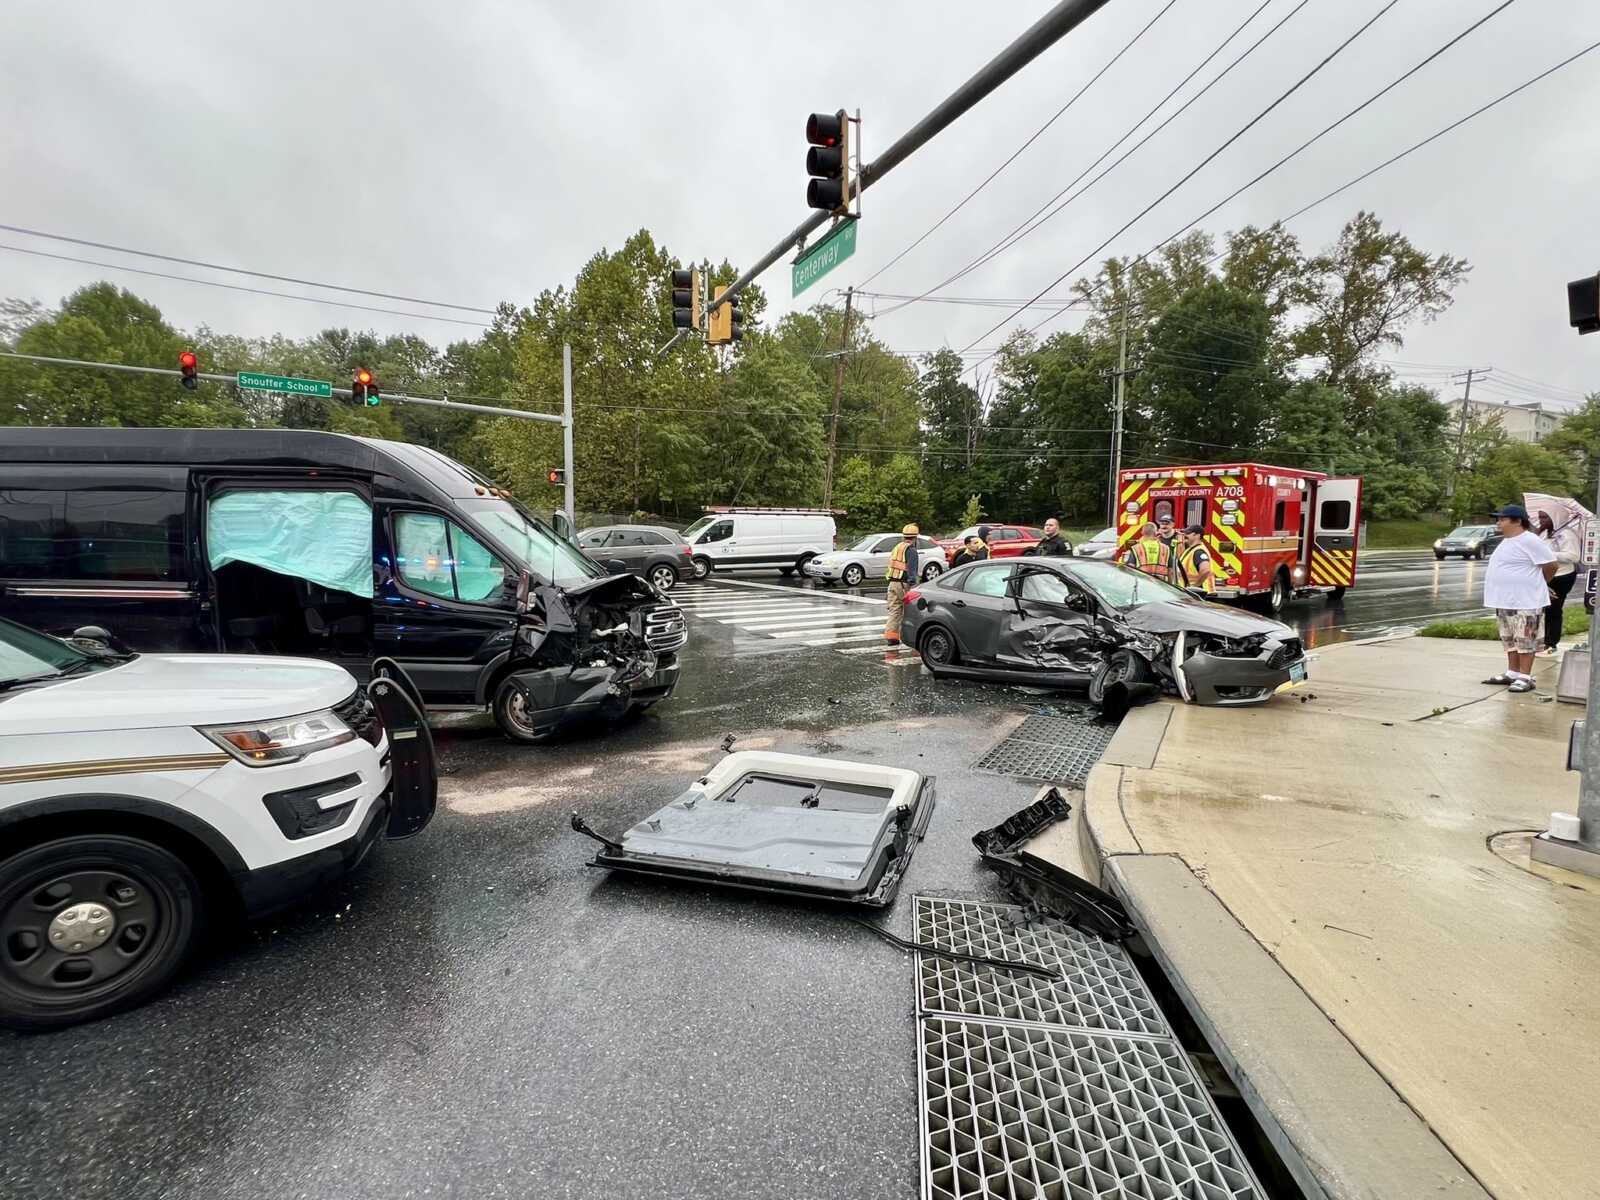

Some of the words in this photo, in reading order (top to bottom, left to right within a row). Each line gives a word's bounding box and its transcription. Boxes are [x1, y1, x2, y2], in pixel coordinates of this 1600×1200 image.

[795, 242, 839, 288] Centerway
[241, 375, 282, 388] Snouffer
[287, 381, 318, 392] School
[1150, 489, 1186, 497] MONTGOMERY
[1188, 488, 1212, 496] COUNTY
[1216, 486, 1244, 497] A708
